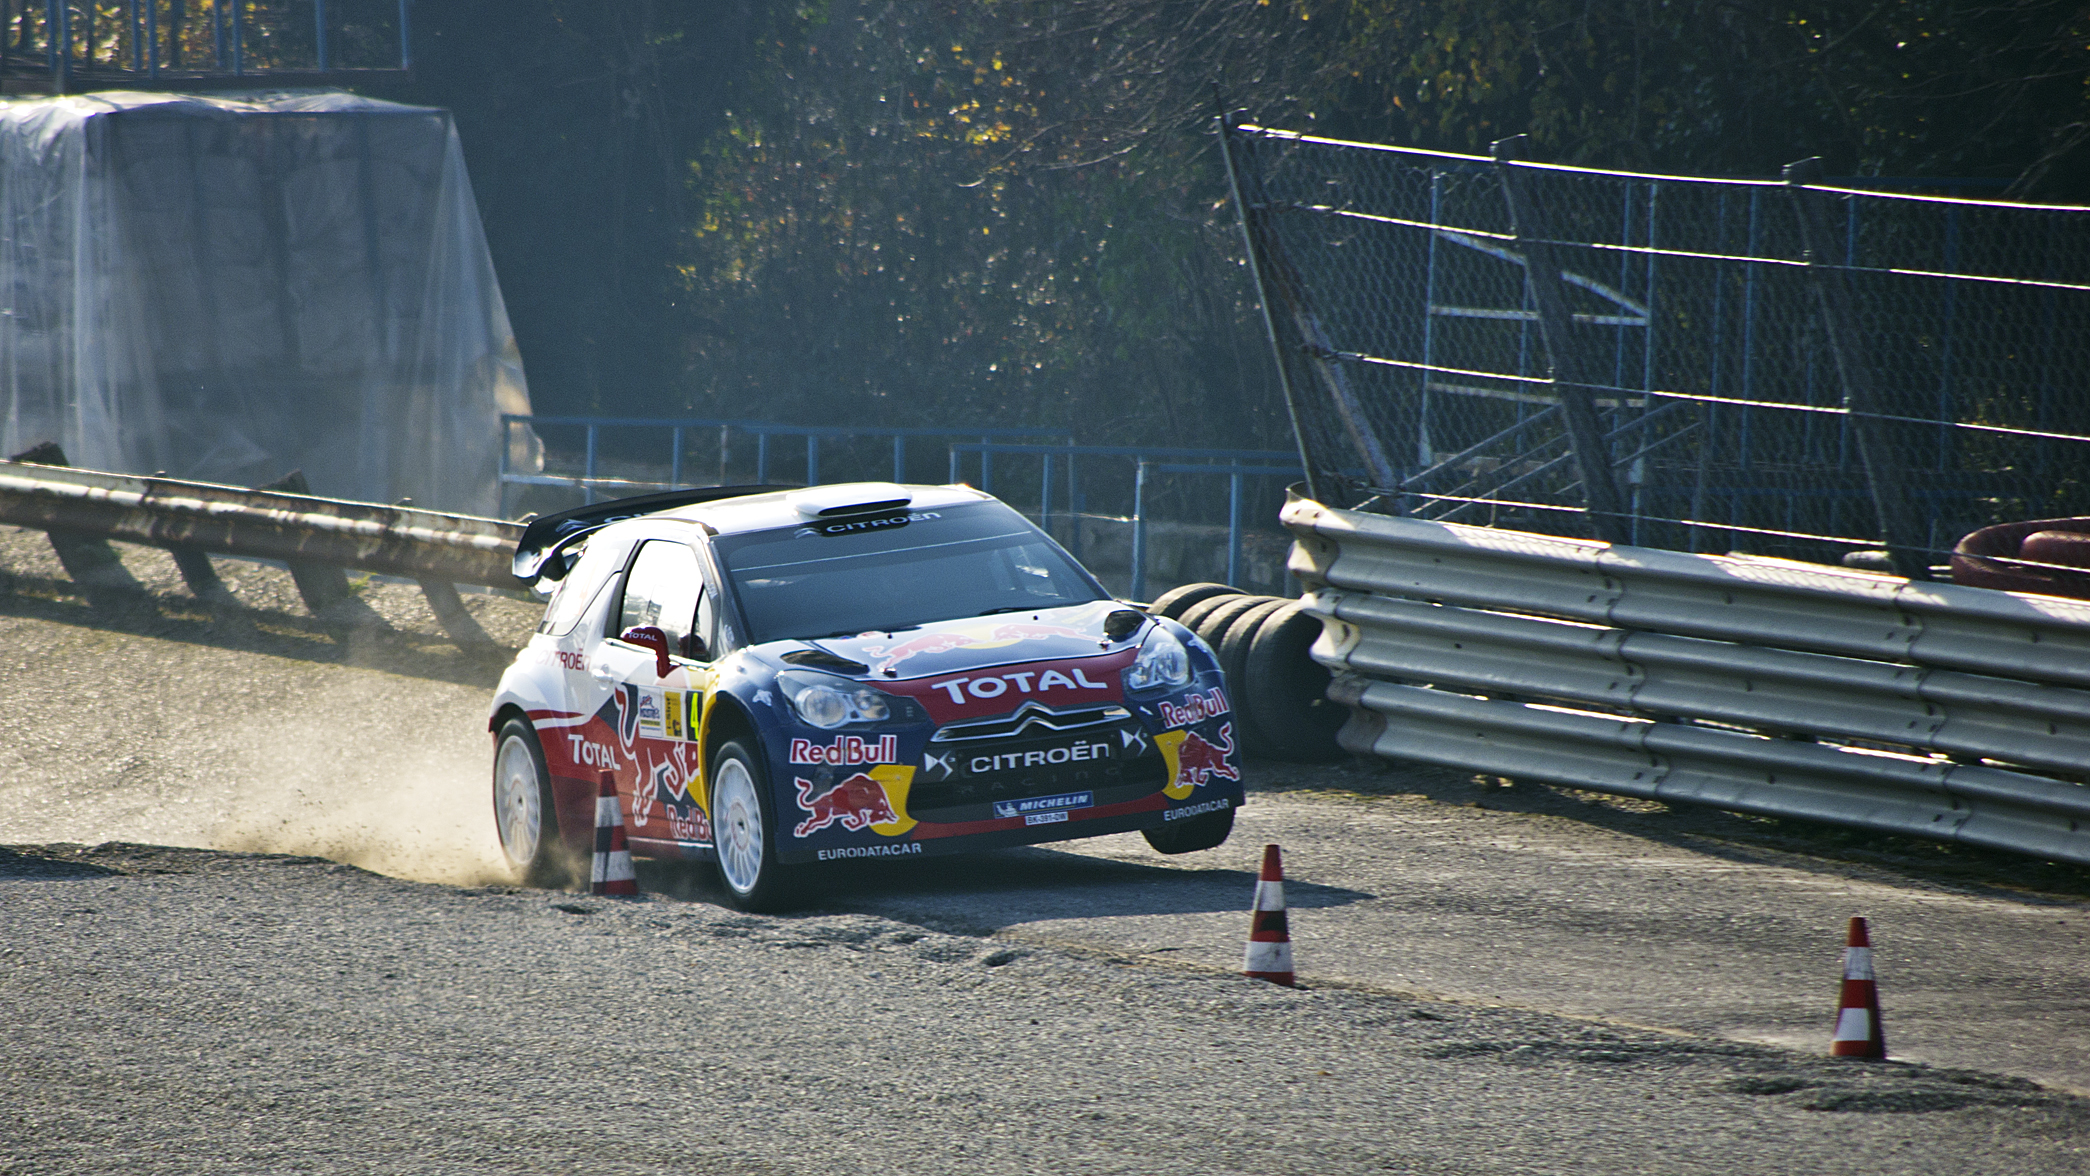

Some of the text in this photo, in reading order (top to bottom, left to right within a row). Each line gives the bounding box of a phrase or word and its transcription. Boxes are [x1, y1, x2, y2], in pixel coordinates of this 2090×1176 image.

[930, 668, 1108, 705] TOTAL
[568, 734, 621, 771] TOTAL
[1019, 794, 1089, 811] MICHELIN
[1163, 798, 1230, 821] EURODATACAR
[817, 842, 922, 861] EURODATACAR
